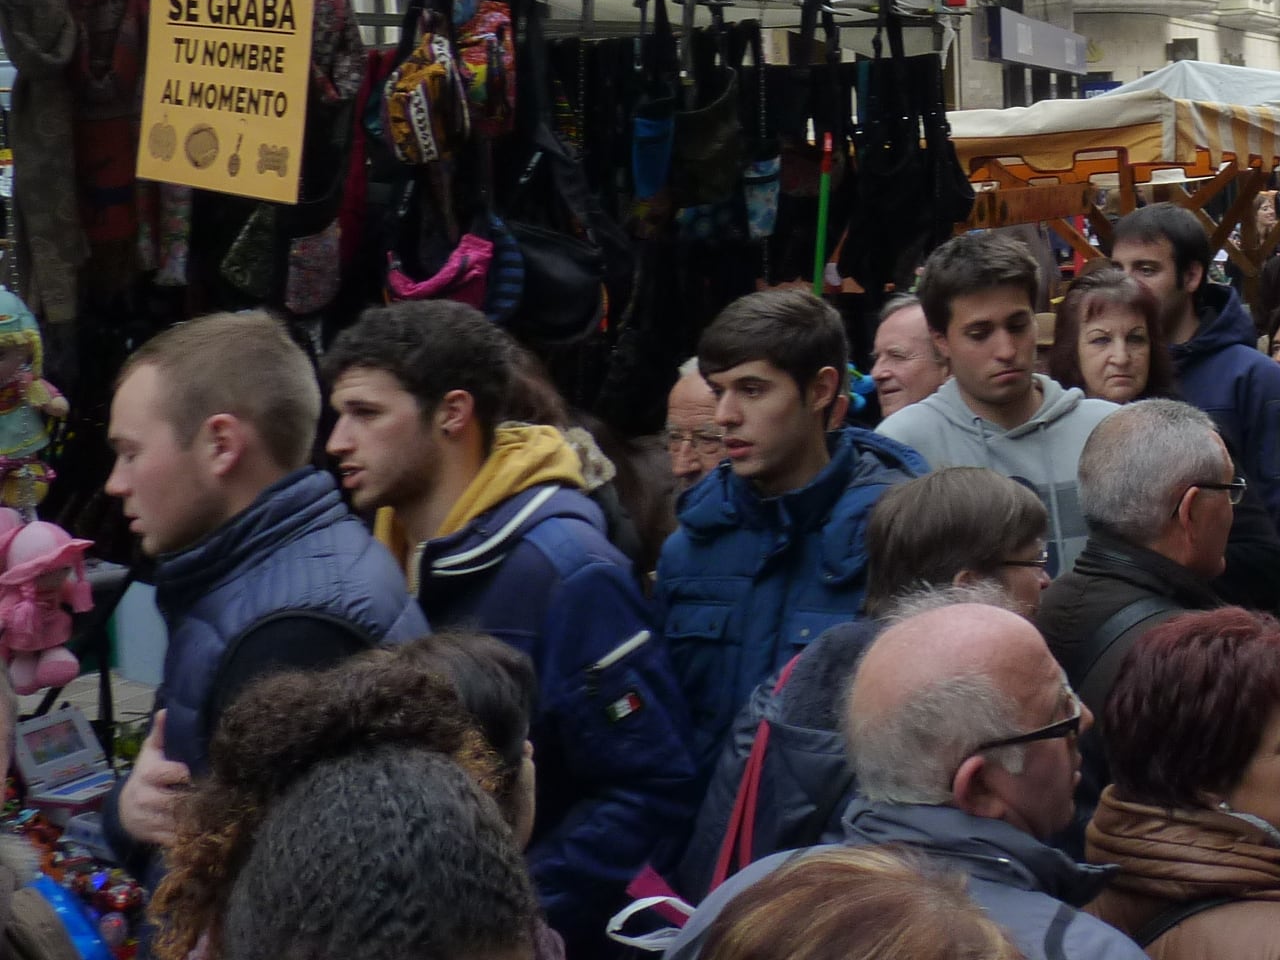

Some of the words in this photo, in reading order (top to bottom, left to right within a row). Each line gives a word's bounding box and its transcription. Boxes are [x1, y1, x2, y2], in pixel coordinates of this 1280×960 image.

[173, 37, 199, 64] TU
[201, 40, 285, 73] NOMBRE
[160, 79, 184, 105] AL
[188, 81, 288, 118] MOMENTO
